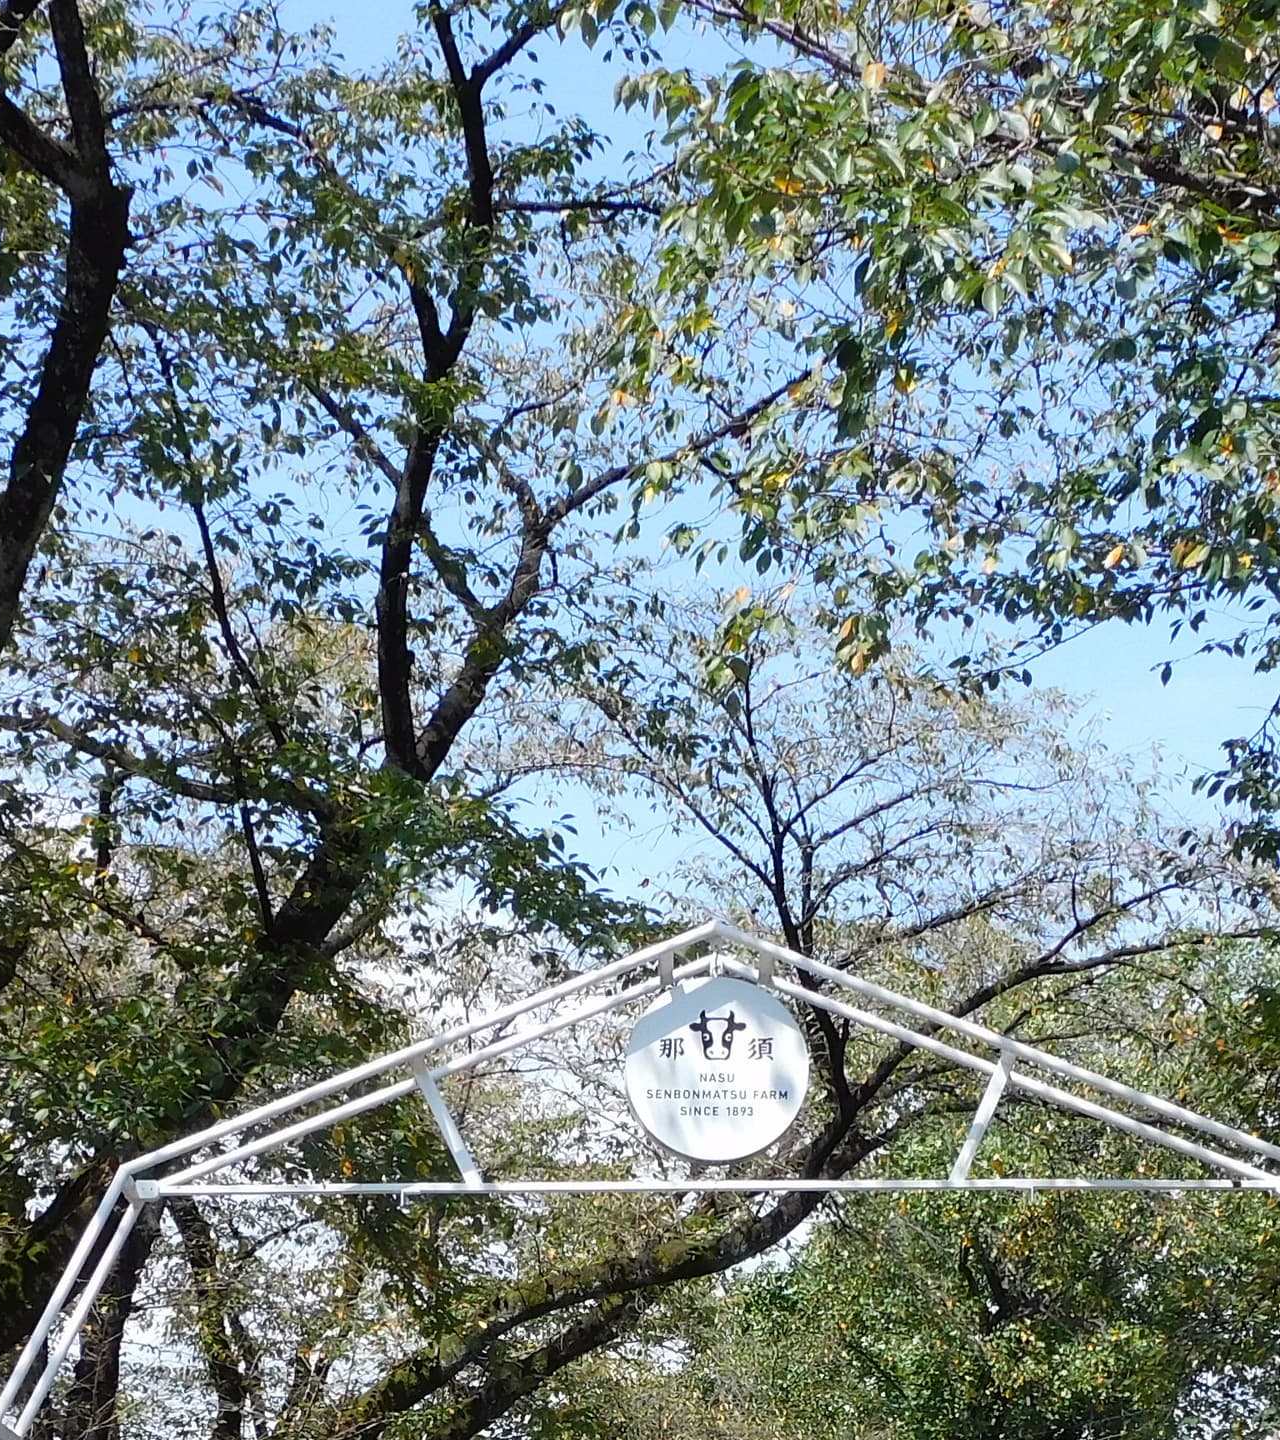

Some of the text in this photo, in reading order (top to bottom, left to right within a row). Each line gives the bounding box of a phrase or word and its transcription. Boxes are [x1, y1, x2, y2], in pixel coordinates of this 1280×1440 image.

[659, 1037, 774, 1061] 那 須
[699, 1072, 735, 1083] NASU
[646, 1089, 788, 1101] SENBONMATSU FARM
[680, 1105, 754, 1117] SINCE 1893
